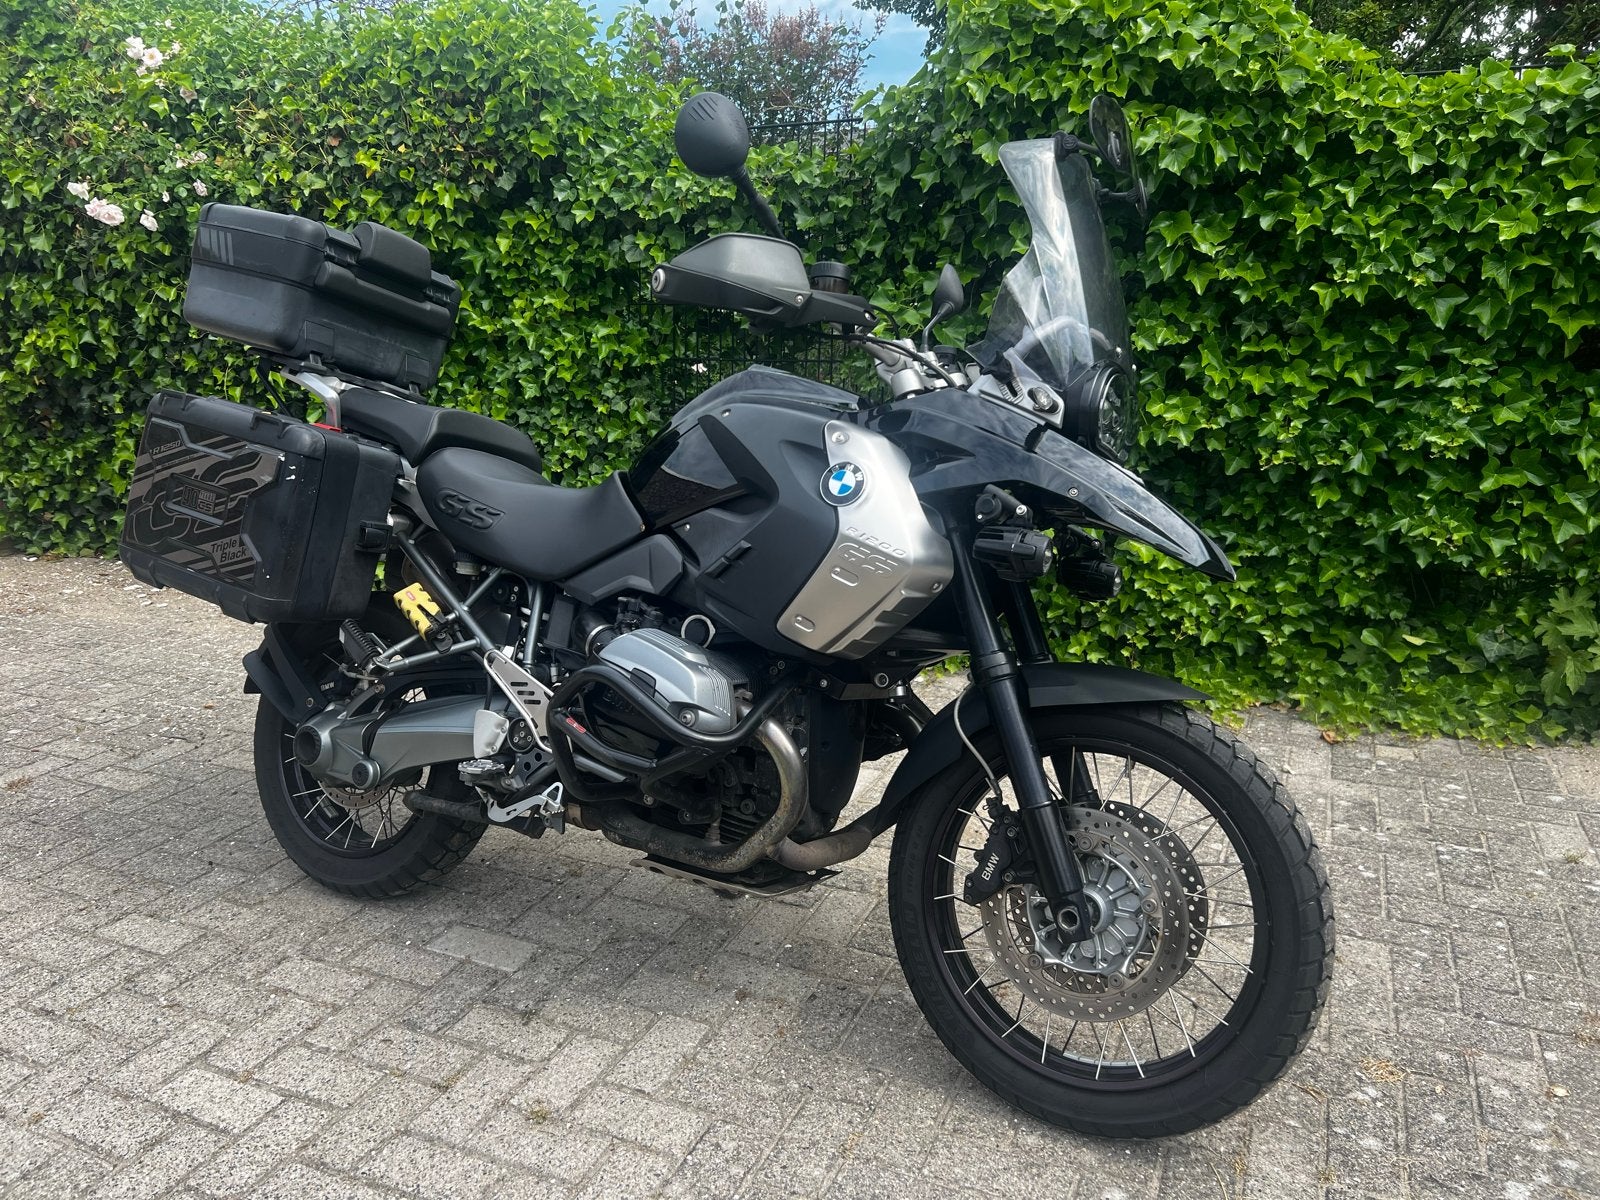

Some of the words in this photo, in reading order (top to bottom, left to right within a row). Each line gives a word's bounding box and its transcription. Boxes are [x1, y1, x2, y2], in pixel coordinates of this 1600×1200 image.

[831, 463, 864, 481] BMW
[437, 490, 502, 530] GS
[210, 538, 237, 553] Triple
[220, 546, 247, 562] Black
[837, 542, 898, 575] GS
[981, 852, 1000, 881] BMW
